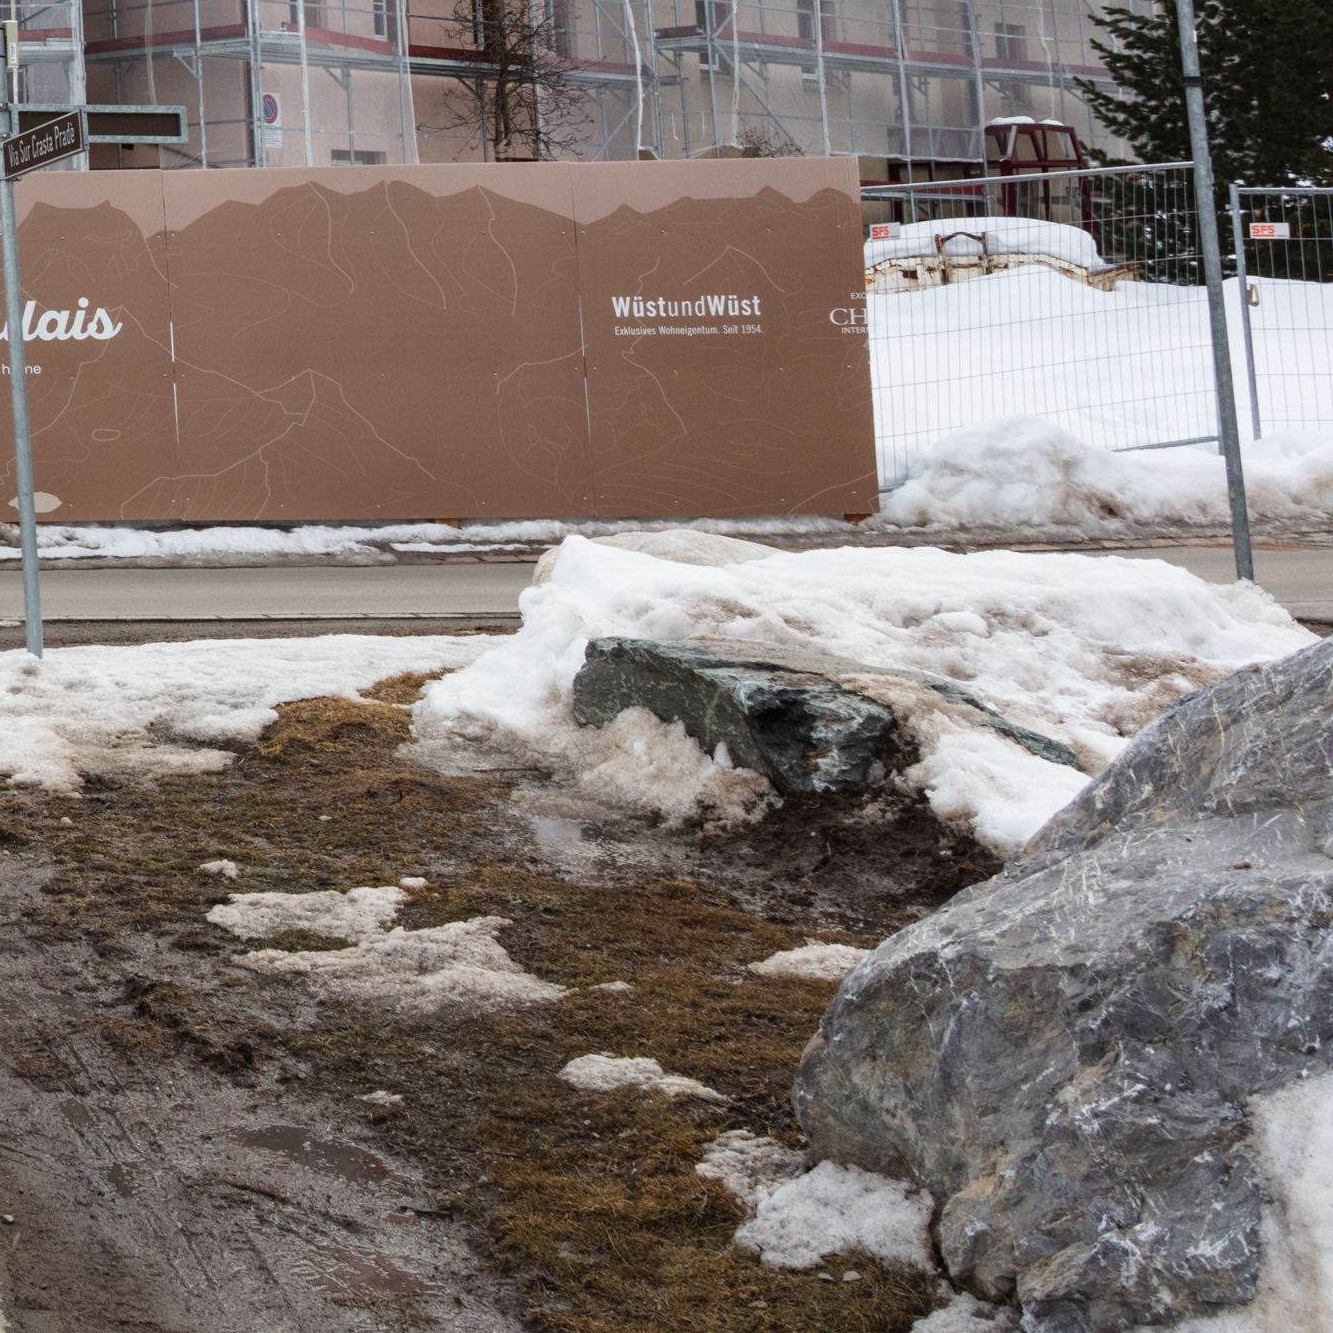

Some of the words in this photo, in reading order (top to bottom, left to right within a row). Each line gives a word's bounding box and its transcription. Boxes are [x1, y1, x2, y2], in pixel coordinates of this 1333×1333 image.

[8, 144, 19, 167] Via
[19, 140, 31, 163] Sur
[31, 133, 54, 158] Crasta
[54, 122, 75, 150] Pradè
[872, 226, 889, 236] SFS
[1252, 225, 1274, 234] SFS
[611, 295, 761, 317] WüstundWüst
[615, 326, 656, 336] Exklusives
[658, 325, 721, 336] Wohneigentum.
[722, 325, 738, 334] Seit
[741, 324, 764, 334] 1954.
[1, 364, 42, 375] hme
